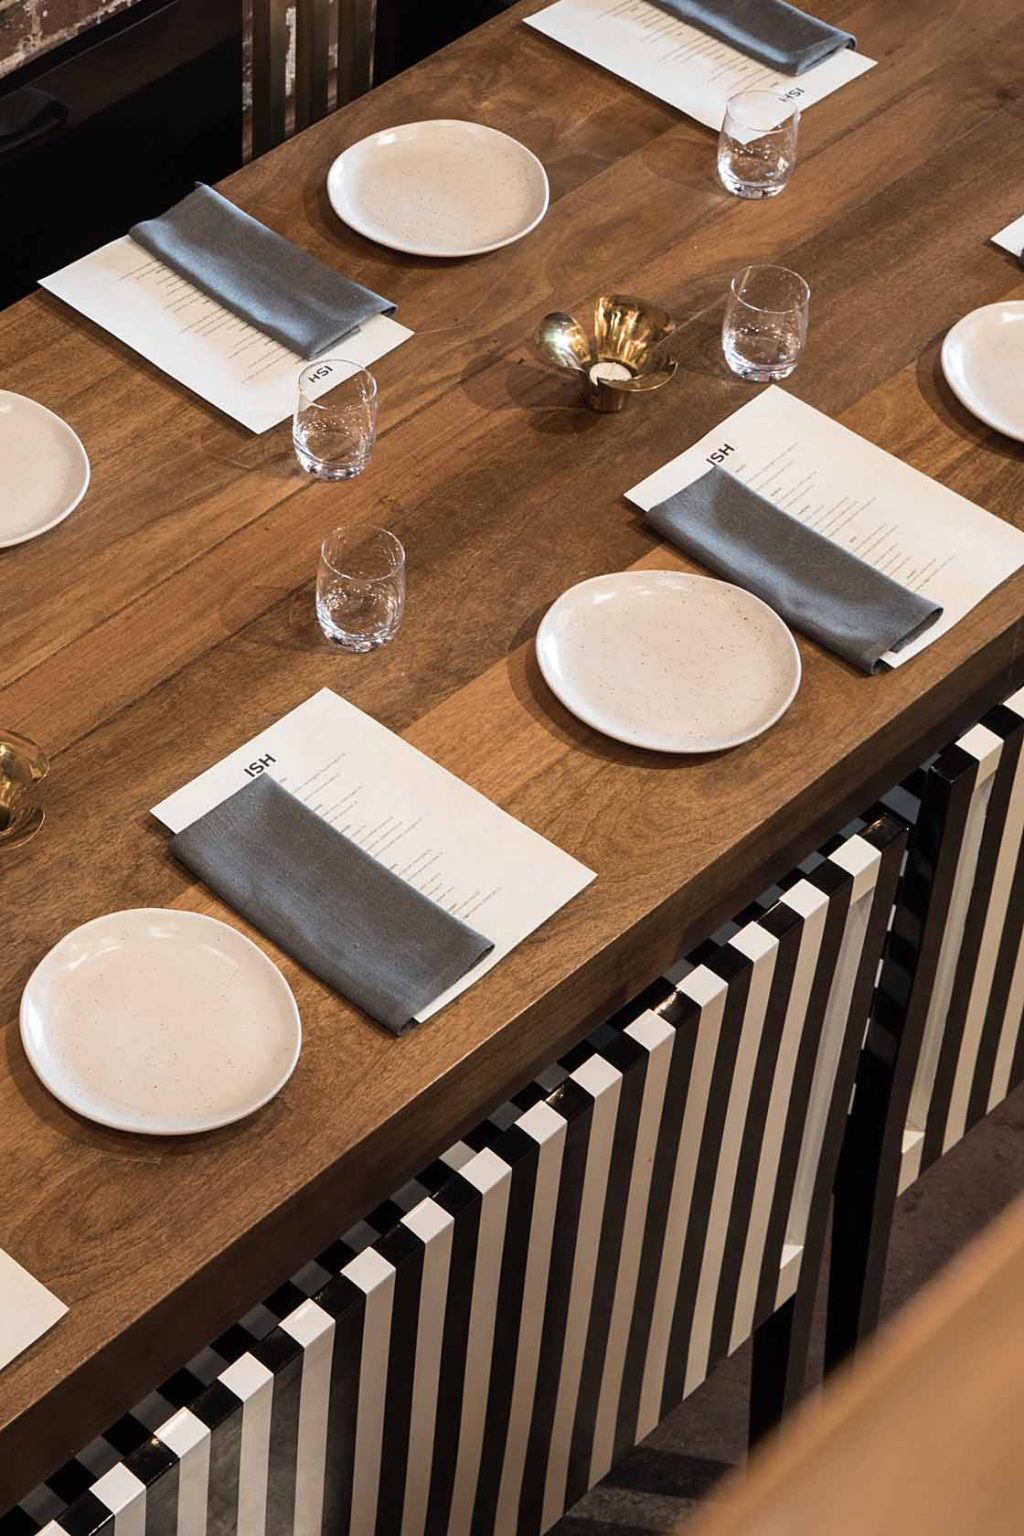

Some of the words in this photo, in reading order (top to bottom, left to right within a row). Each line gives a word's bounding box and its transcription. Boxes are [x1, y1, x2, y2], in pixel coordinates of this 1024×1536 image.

[308, 365, 333, 383] ISH
[706, 443, 735, 466] ISH
[244, 753, 277, 778] ISH
